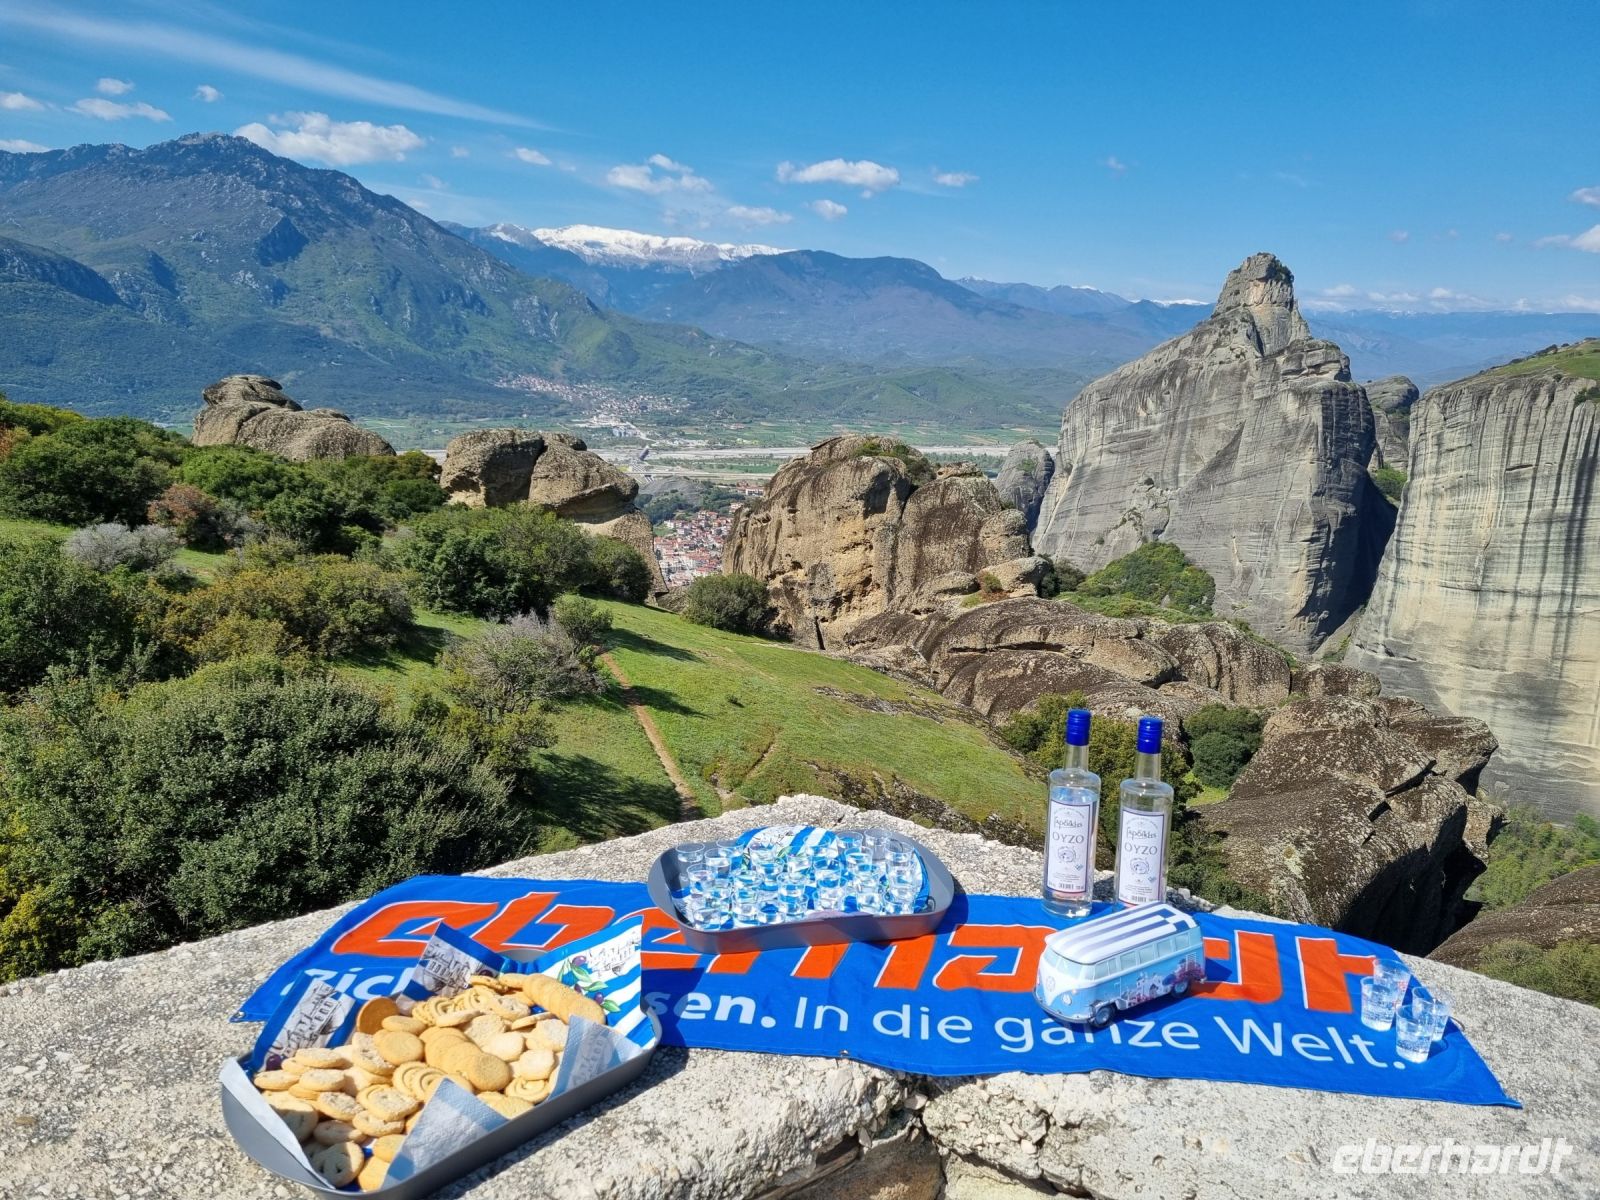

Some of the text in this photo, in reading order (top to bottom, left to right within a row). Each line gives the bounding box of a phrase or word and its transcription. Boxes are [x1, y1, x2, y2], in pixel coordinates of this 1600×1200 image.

[795, 996, 850, 1032] In
[872, 1003, 973, 1044] die
[994, 1016, 1202, 1053] ganze
[1213, 1016, 1406, 1070] Welt.
